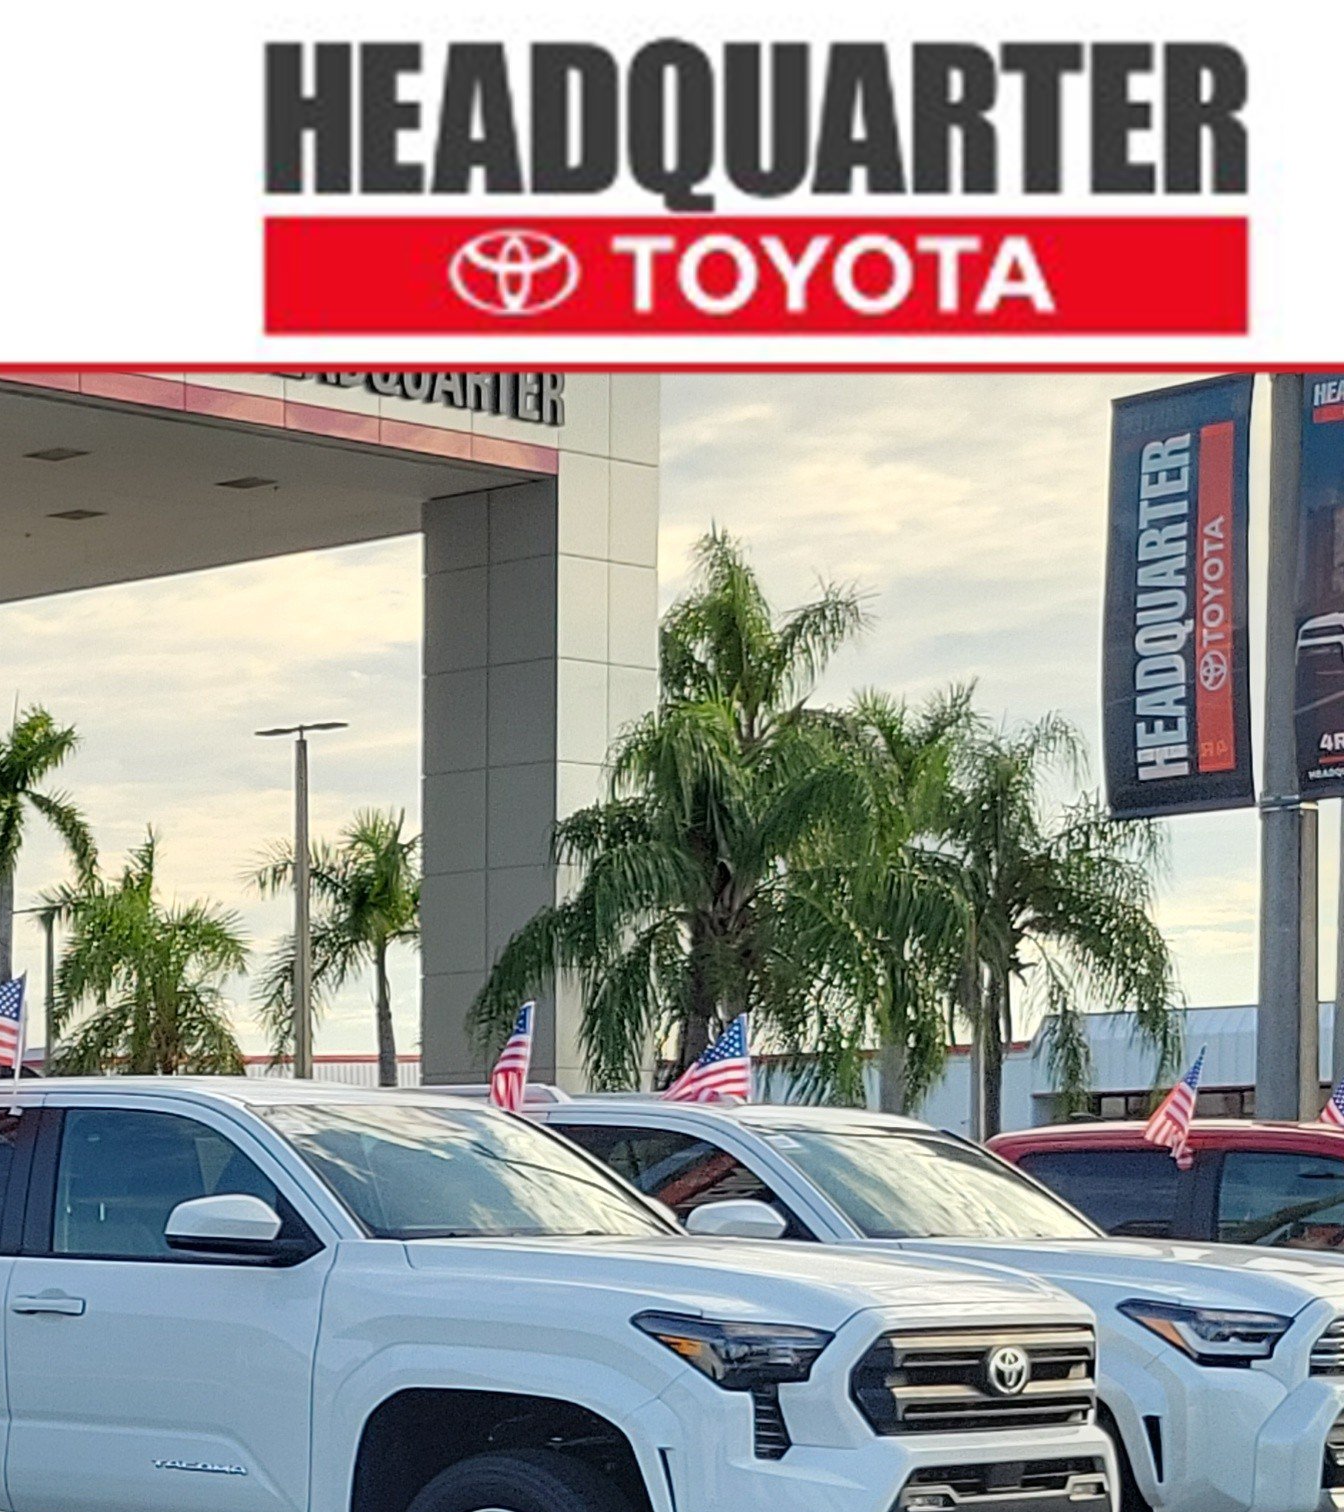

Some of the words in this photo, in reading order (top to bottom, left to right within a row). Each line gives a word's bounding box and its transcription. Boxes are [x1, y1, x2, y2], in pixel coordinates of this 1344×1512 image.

[1135, 432, 1194, 781] HEADQUARTER
[1201, 515, 1225, 647] TOYOTA
[151, 1459, 248, 1476] TACOMA
